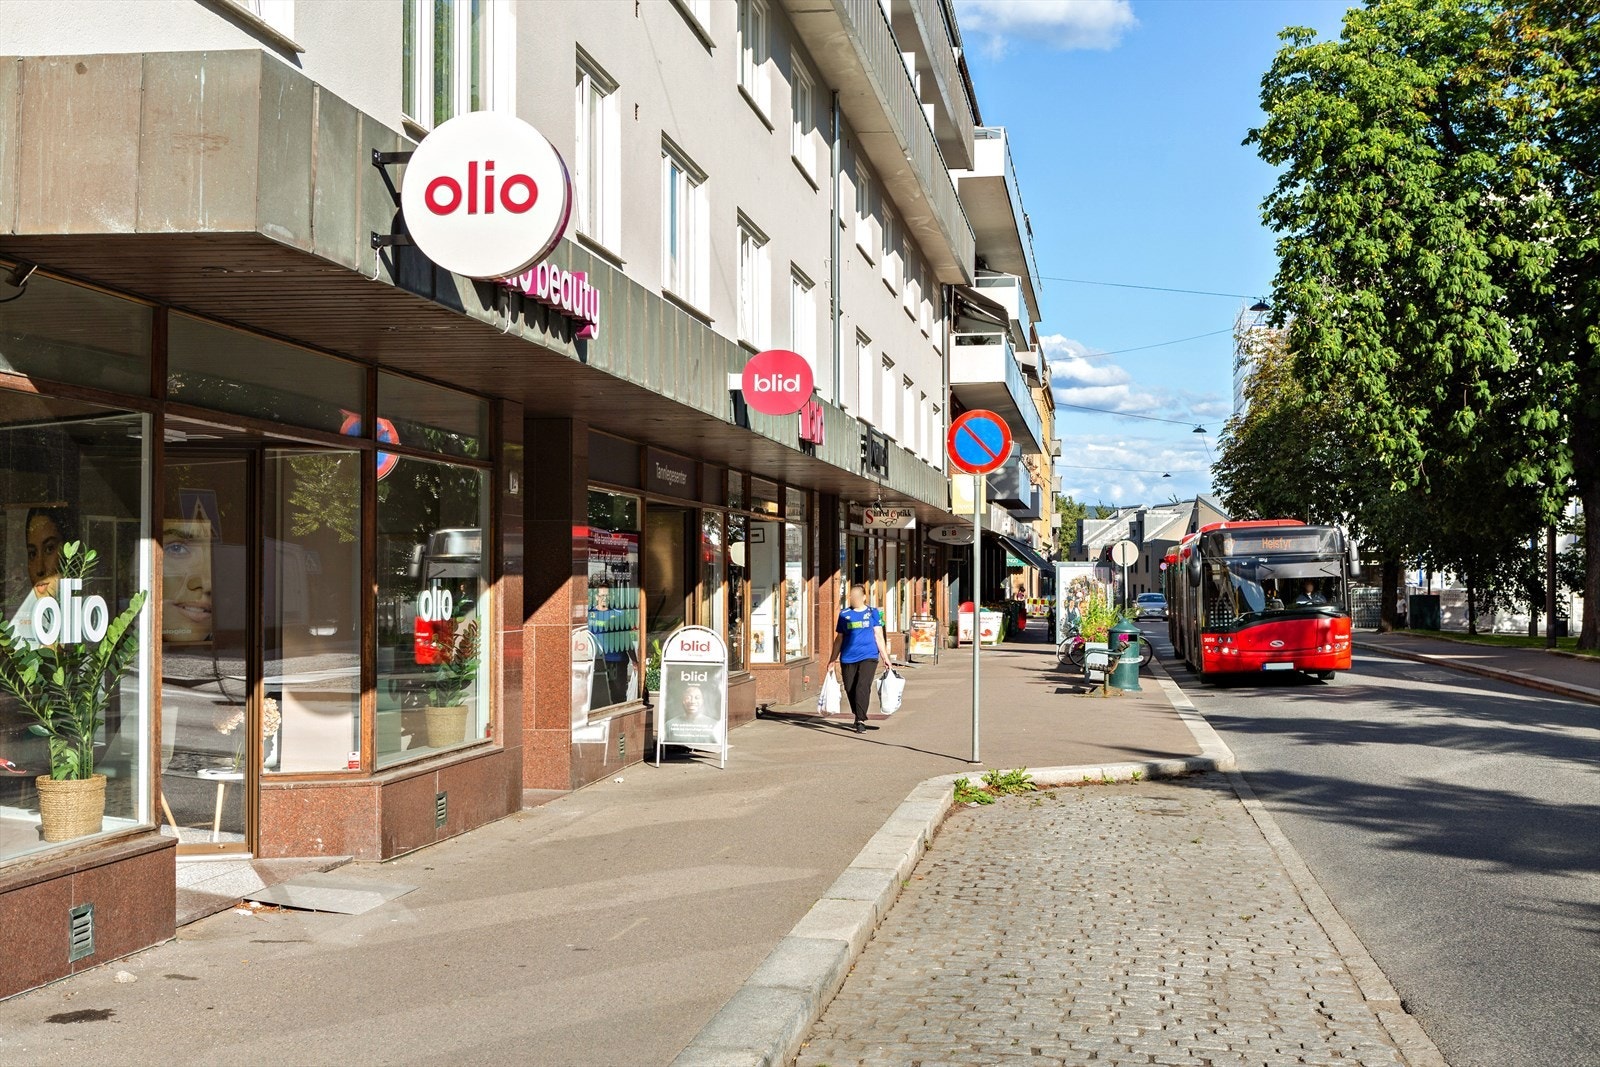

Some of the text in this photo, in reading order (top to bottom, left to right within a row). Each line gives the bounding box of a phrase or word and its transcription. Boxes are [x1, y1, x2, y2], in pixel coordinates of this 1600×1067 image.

[424, 160, 538, 216] olio
[536, 259, 600, 340] beauty
[754, 373, 800, 392] blid
[655, 461, 688, 486] Tannlegesenter
[31, 578, 109, 646] olio
[416, 578, 453, 622] olio
[680, 640, 711, 652] blid
[680, 670, 708, 682] blid
